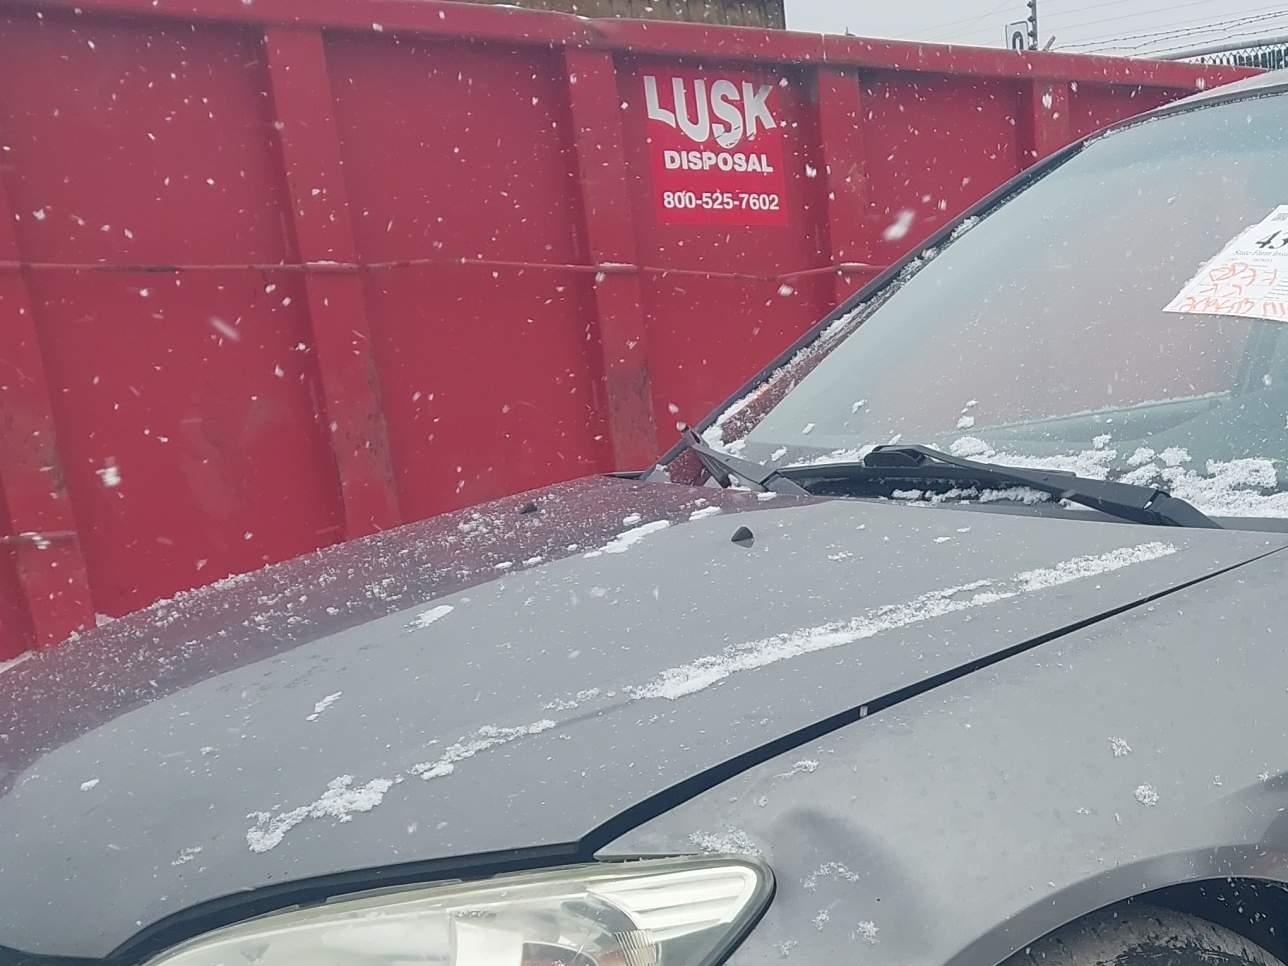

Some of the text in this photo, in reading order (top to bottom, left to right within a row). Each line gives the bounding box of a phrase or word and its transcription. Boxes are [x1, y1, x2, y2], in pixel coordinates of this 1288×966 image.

[643, 75, 777, 149] LUSK
[664, 151, 774, 172] DISPOSAL
[663, 192, 780, 210] 800-525-7602
